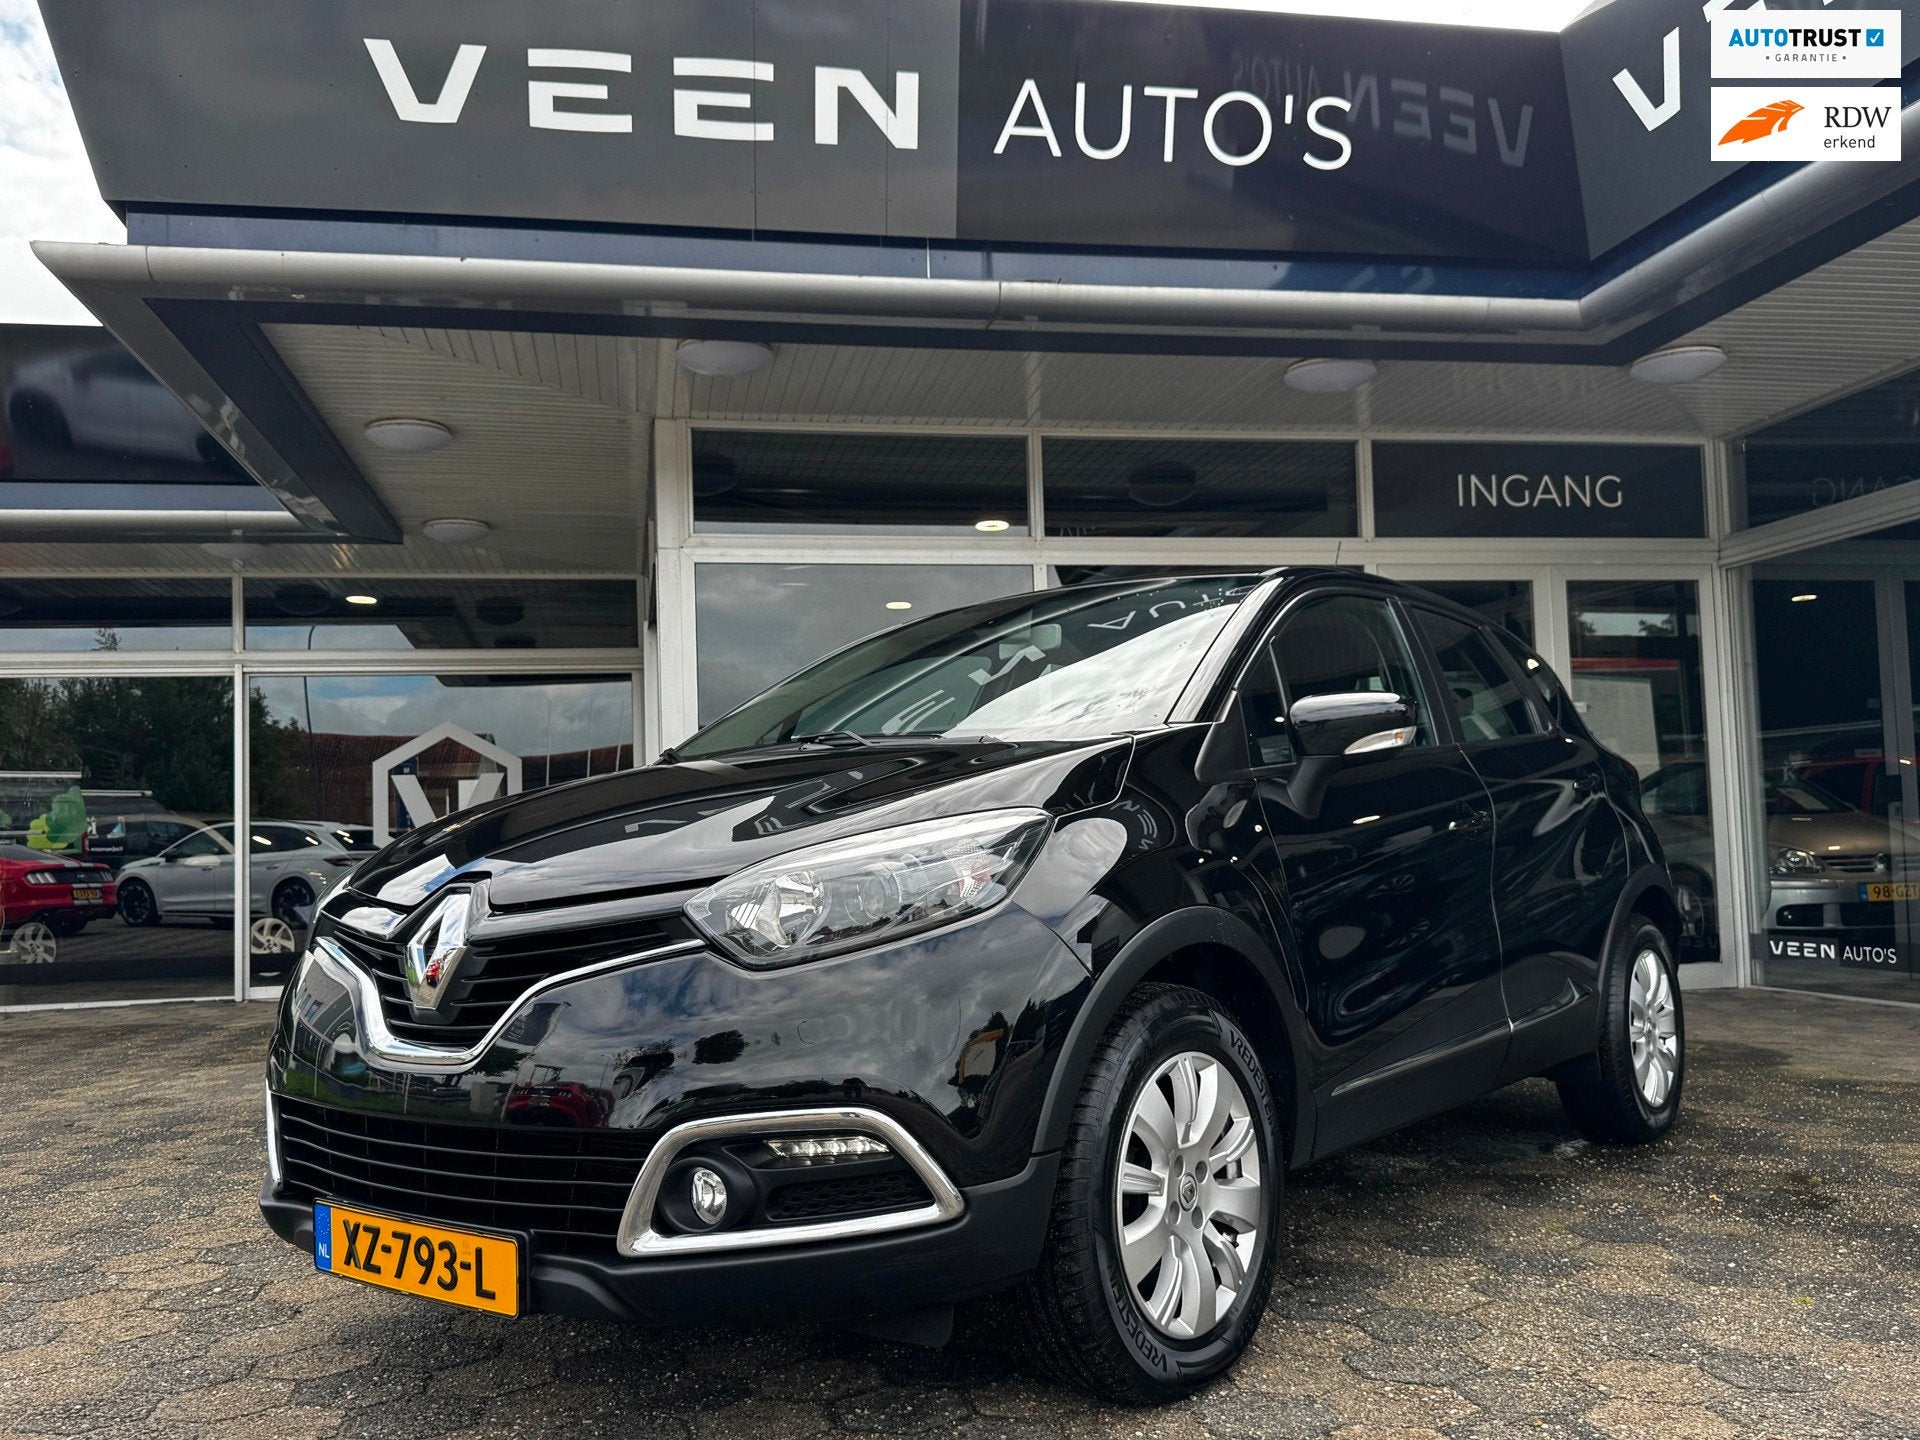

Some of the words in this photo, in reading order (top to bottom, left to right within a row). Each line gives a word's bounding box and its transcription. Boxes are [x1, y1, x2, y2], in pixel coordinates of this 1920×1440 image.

[363, 38, 919, 149] VEEN
[993, 78, 1352, 171] AUTO'S
[1457, 473, 1623, 508] INGANG
[1769, 940, 1836, 960] VEEN
[1843, 945, 1897, 964] AUTO'S
[318, 1242, 330, 1259] NL
[342, 1219, 496, 1300] XZ-793-L
